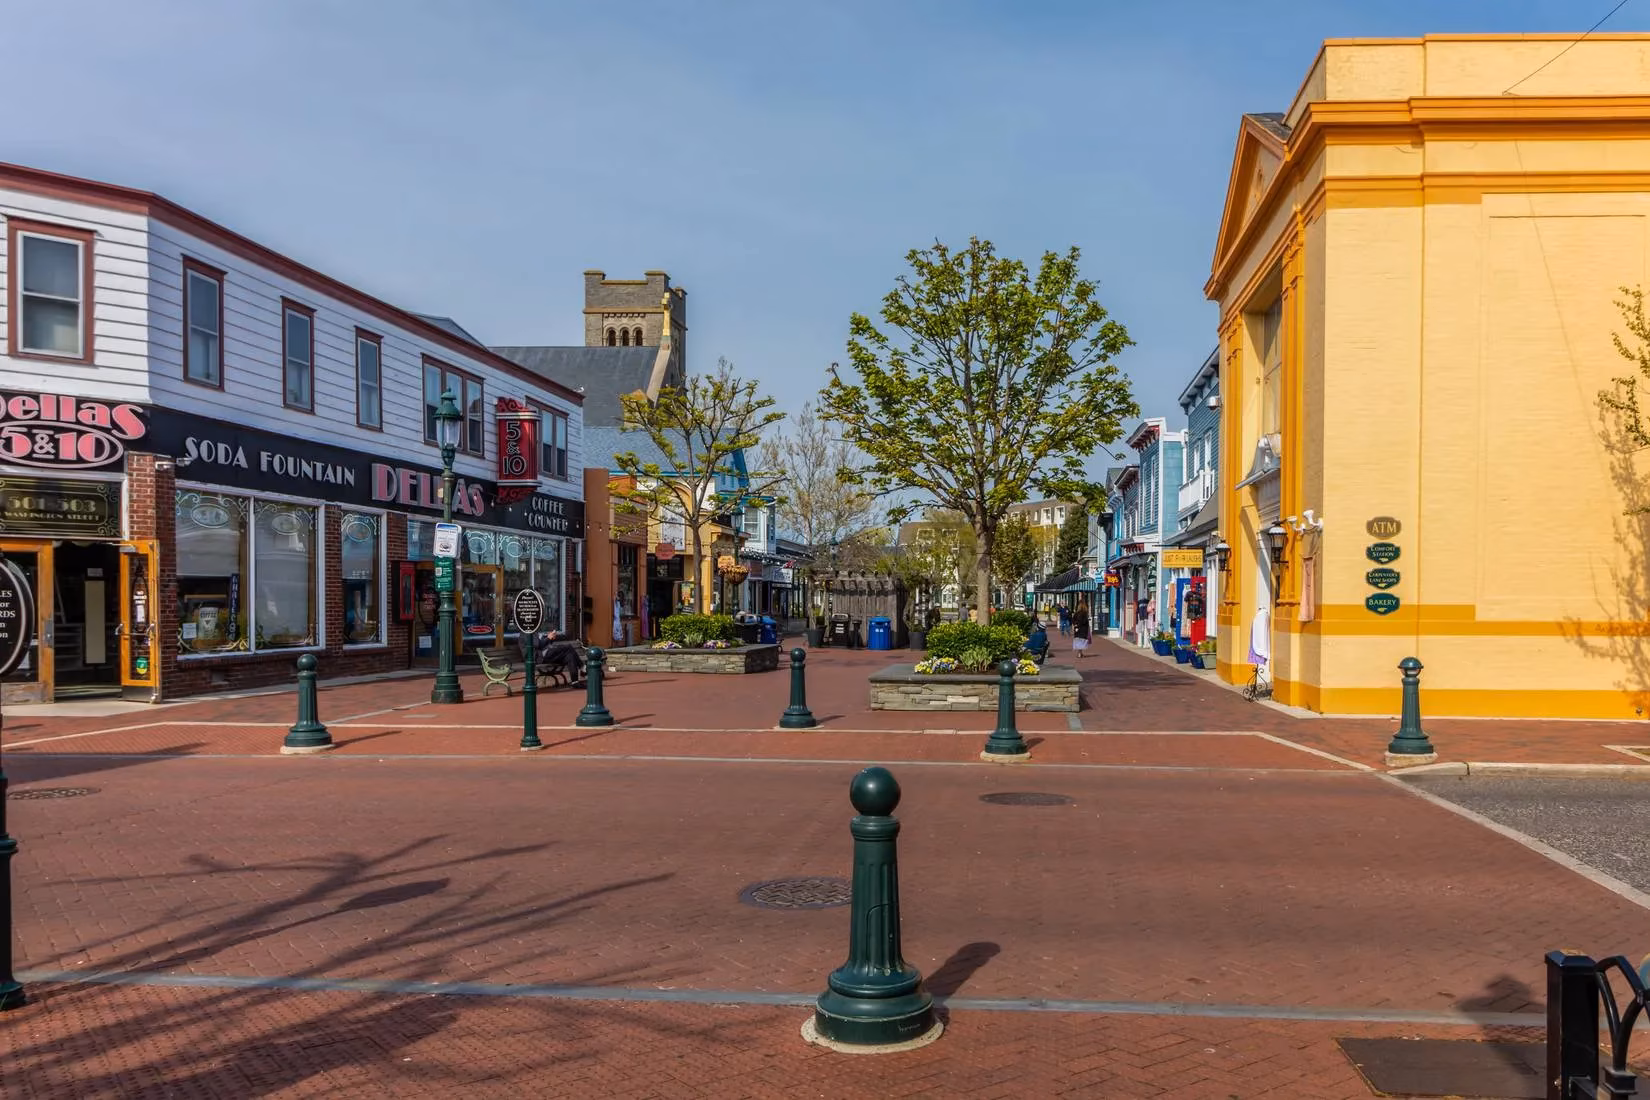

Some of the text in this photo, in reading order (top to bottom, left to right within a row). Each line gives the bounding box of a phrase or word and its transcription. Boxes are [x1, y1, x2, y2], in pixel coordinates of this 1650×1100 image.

[505, 421, 521, 441] 5
[184, 436, 356, 488] SODA FOUNTAIN
[503, 455, 528, 476] 10
[531, 496, 566, 516] COFFEE
[528, 512, 568, 532] COUNTER
[1371, 521, 1397, 533] ATM
